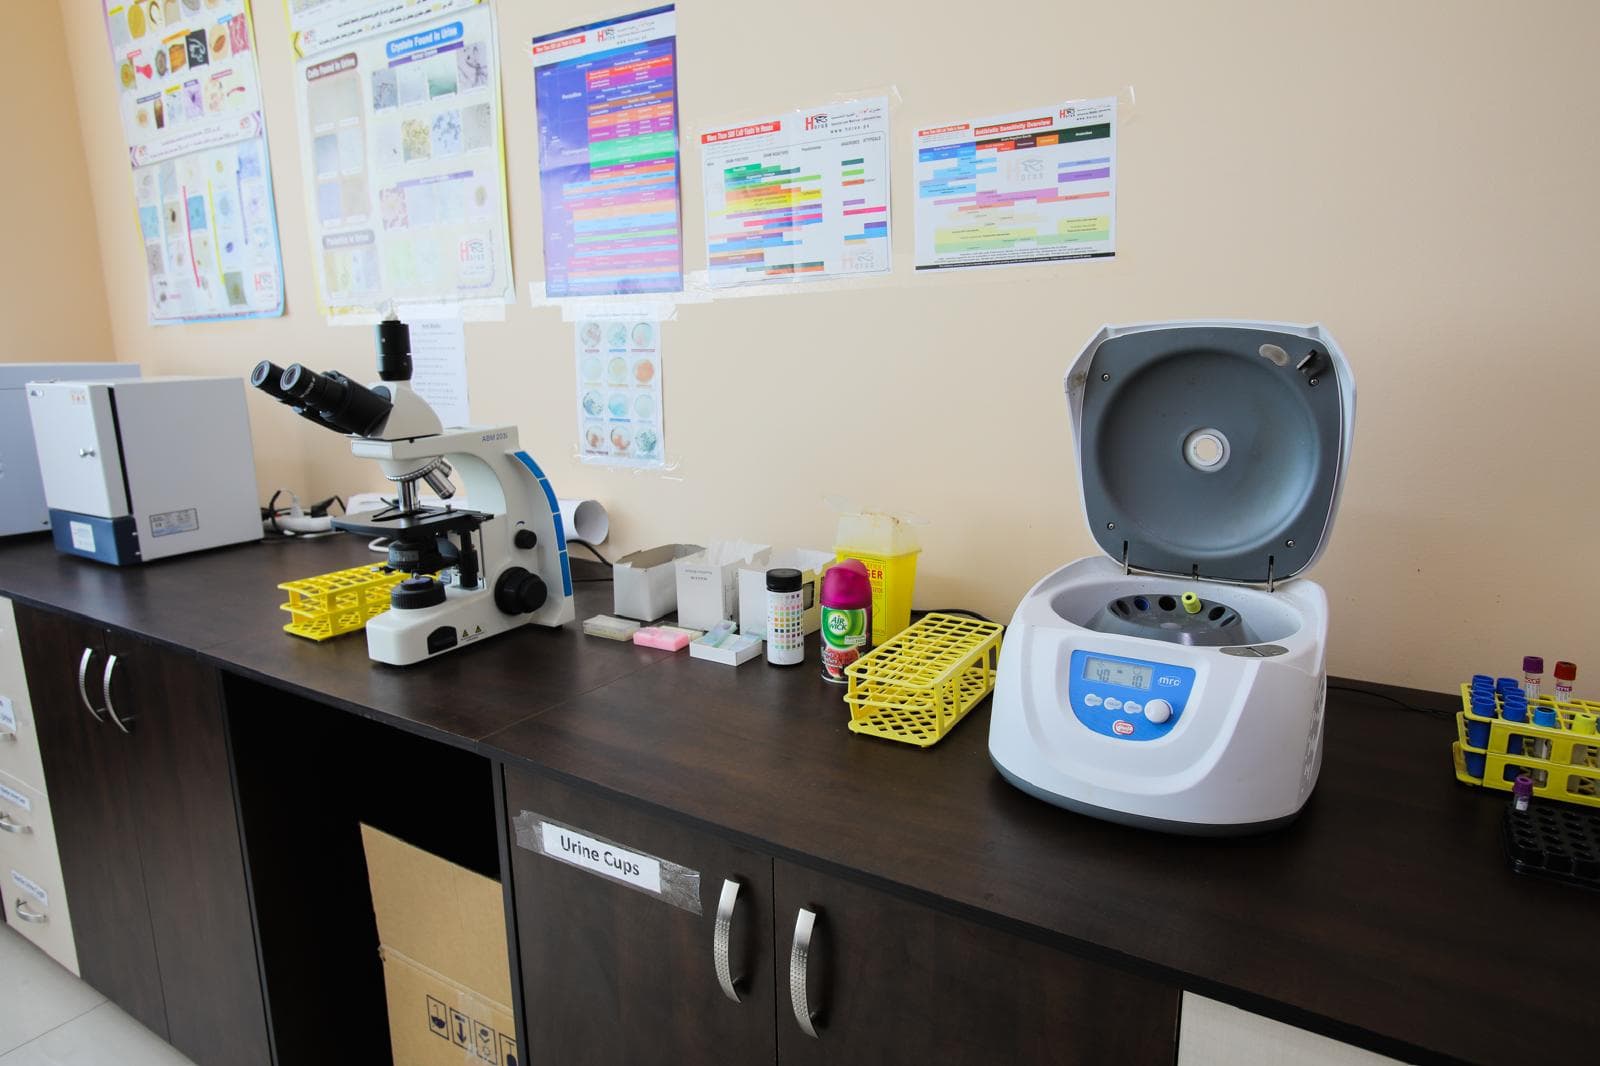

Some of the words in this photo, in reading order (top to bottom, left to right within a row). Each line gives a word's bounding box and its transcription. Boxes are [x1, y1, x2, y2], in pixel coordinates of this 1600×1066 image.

[413, 34, 433, 48] Found
[440, 27, 458, 38] Urine
[975, 126, 999, 136] Antibiotic
[999, 122, 1026, 132] Sensitivity
[1027, 119, 1051, 129] Overview
[1159, 676, 1181, 687] mrc
[560, 835, 600, 861] Urine
[603, 851, 640, 876] Cups
